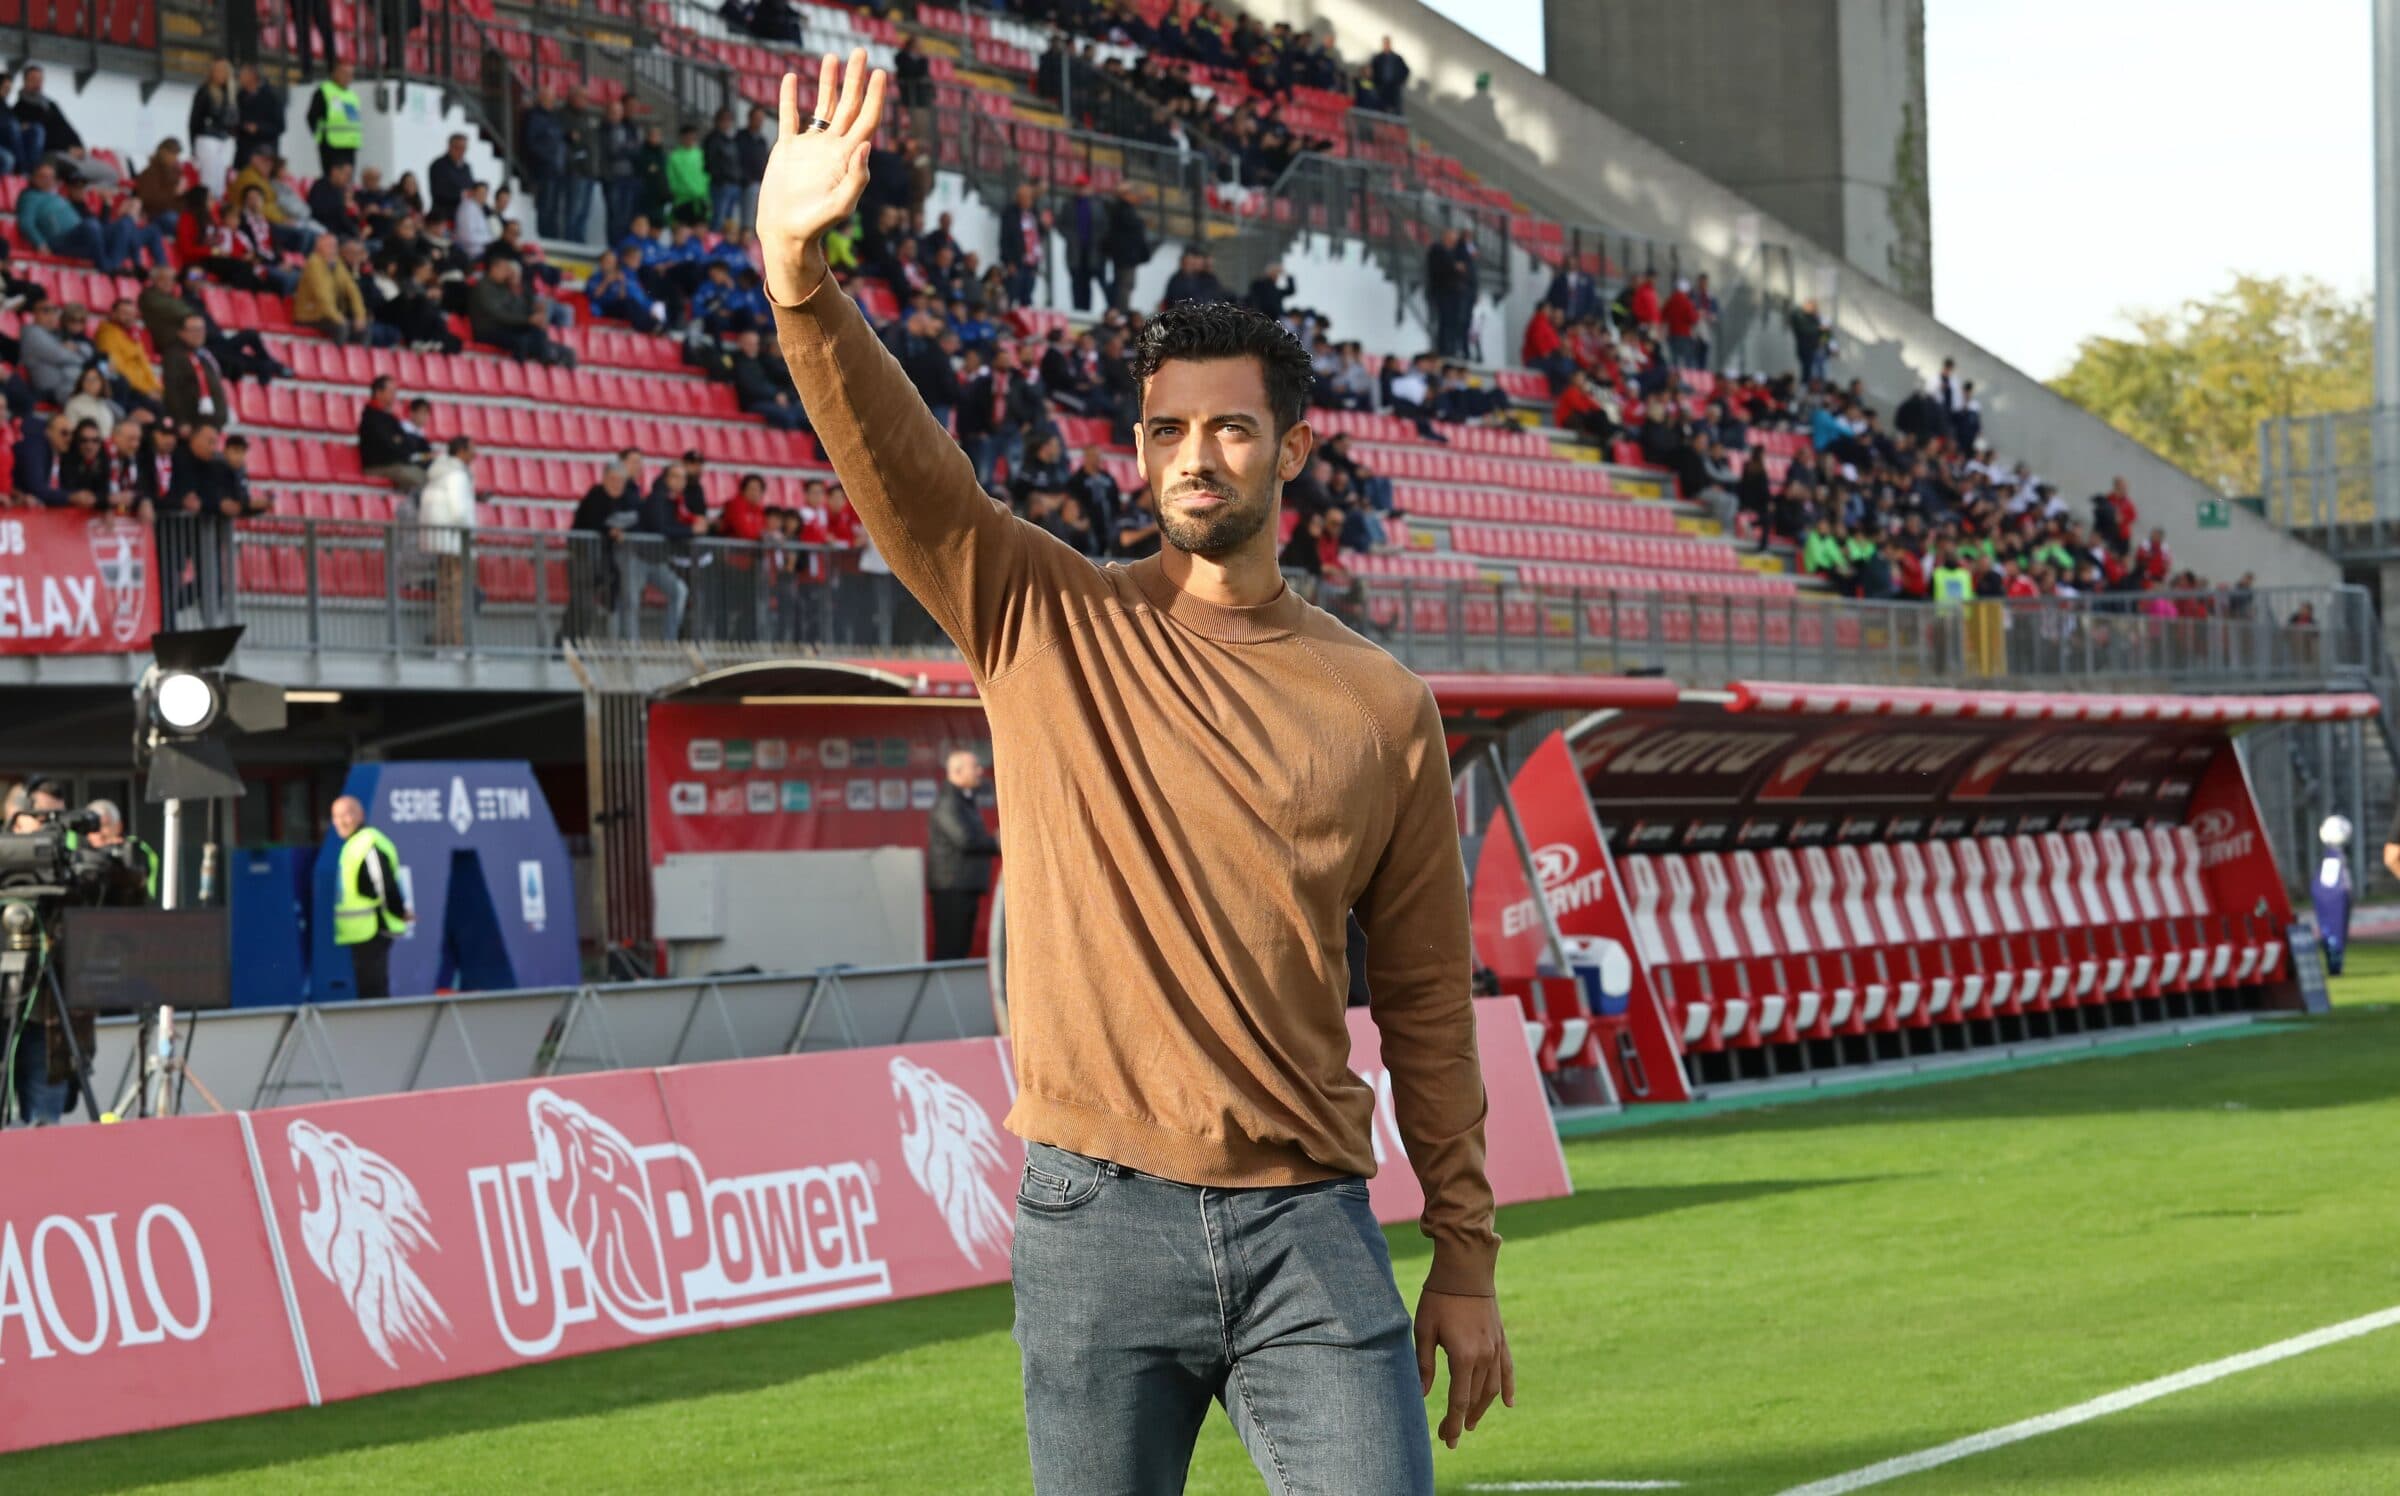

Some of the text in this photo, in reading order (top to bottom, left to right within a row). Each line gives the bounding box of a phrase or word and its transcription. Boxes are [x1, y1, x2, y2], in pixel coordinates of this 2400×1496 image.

[389, 788, 443, 823] SERIE
[1503, 869, 1604, 938] ENRVIT
[0, 1203, 212, 1365] AOLO
